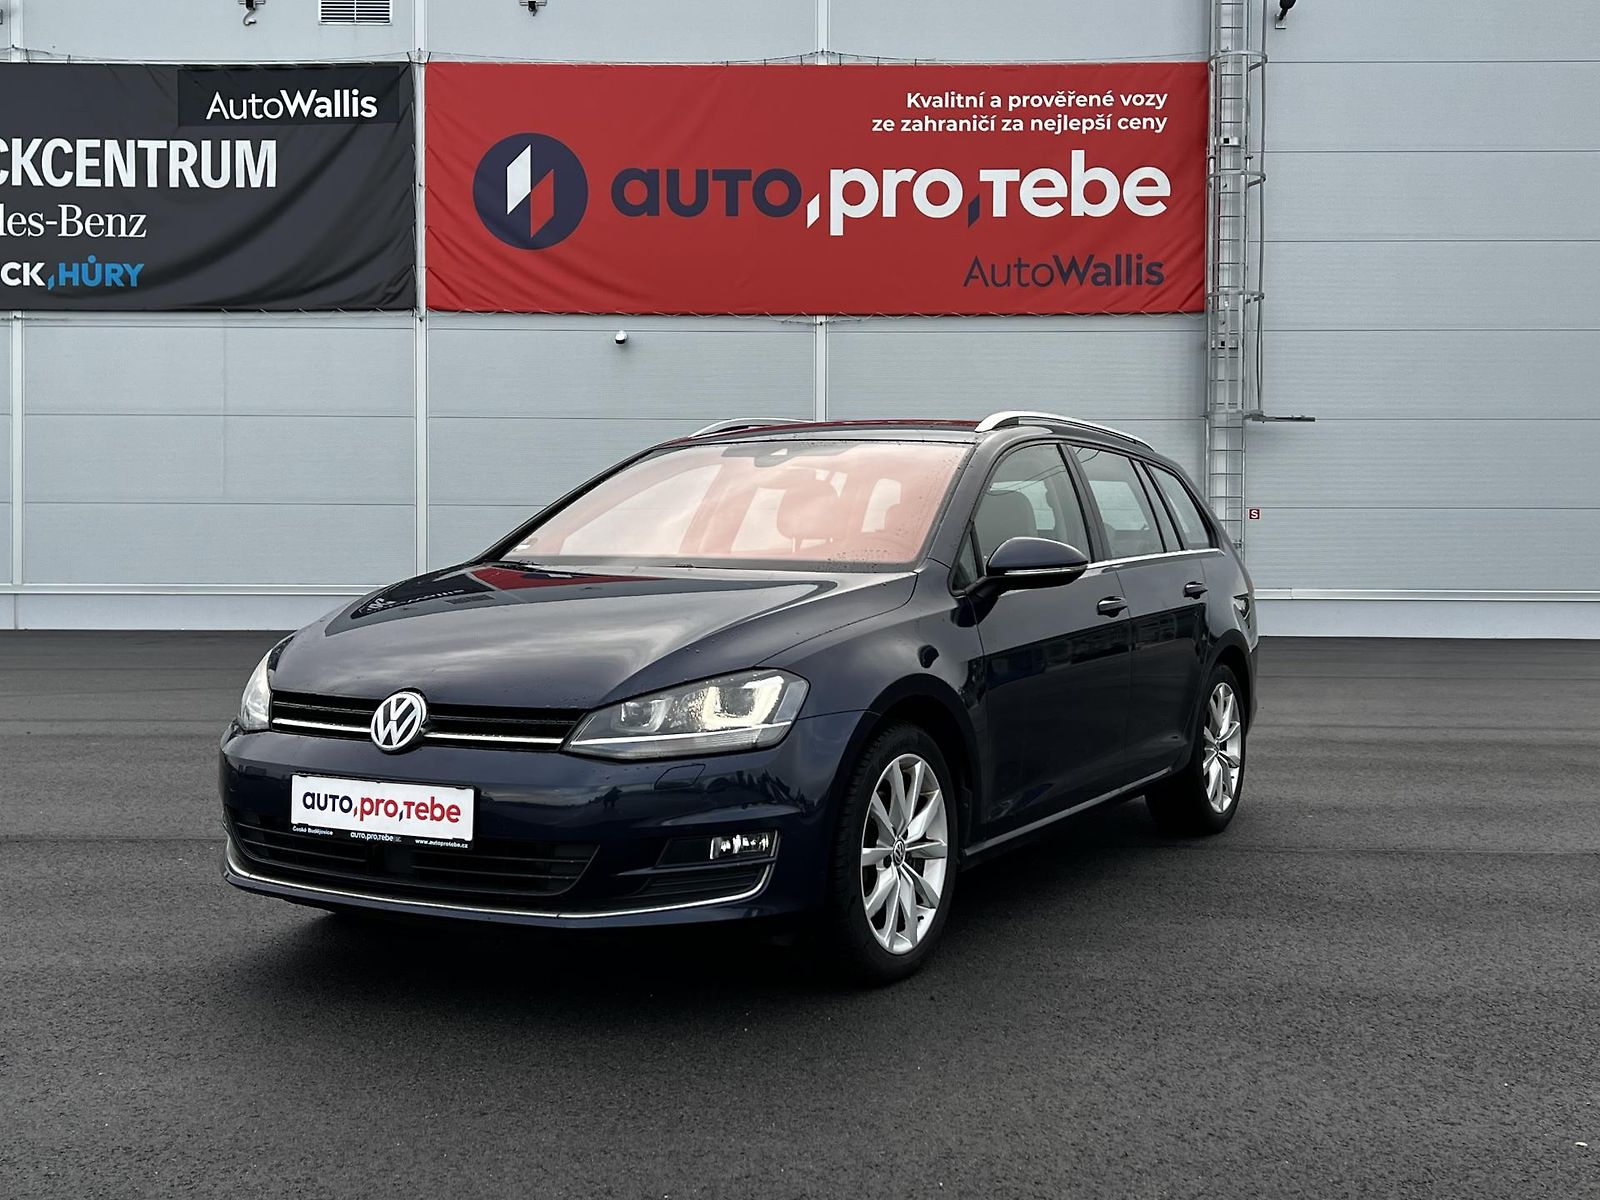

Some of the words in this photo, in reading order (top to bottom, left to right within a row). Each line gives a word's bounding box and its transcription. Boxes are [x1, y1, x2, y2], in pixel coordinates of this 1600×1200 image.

[206, 89, 377, 119] AutoWallis
[907, 91, 985, 108] Kvalitní
[989, 95, 1002, 108] a
[1008, 90, 1114, 111] prověřené
[1120, 93, 1168, 109] vozy
[872, 118, 895, 132] ze
[901, 115, 996, 132] zahraničí
[1002, 118, 1024, 131] za
[1030, 113, 1112, 134] nejlepší
[1117, 116, 1168, 133] ceny
[0, 138, 277, 188] KCENTRUM
[0, 203, 147, 237] es-Benz
[963, 253, 1165, 288] AutoWallis
[1250, 509, 1259, 519] S
